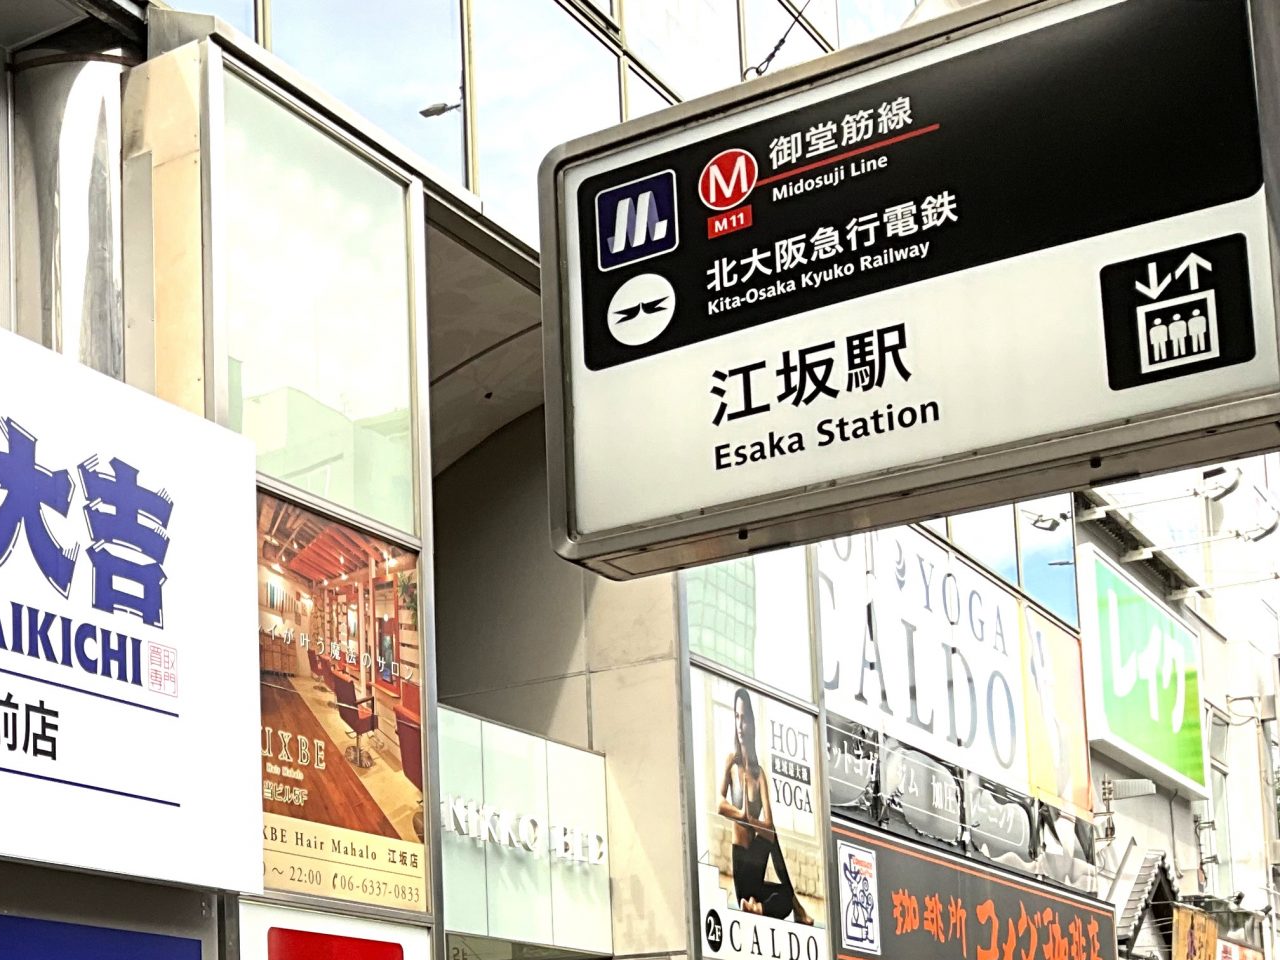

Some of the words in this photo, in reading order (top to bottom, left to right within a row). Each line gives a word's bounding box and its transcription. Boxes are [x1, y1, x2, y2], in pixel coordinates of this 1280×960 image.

[769, 96, 913, 170] 御堂筋線
[772, 166, 845, 202] Midosuji
[851, 155, 888, 178] Line
[706, 190, 959, 292] 北大阪急行電鉄
[714, 213, 745, 233] M11
[708, 279, 796, 315] Kita-Osaka
[801, 262, 855, 288] Kyuko
[860, 241, 930, 272] Railway
[710, 322, 912, 427] 江坂駅
[715, 431, 806, 470] Esaka
[817, 400, 940, 447] Station
[916, 553, 1008, 657] YOGA
[770, 720, 808, 762] HOT
[263, 780, 308, 806] 当ビル5F
[772, 778, 813, 813] YOGA
[295, 832, 325, 851] Hair
[331, 839, 377, 860] Mahalo
[387, 849, 419, 869] 江坂店
[289, 866, 322, 885] 22:00
[340, 875, 420, 903] 06-6337-0833
[707, 917, 722, 942] 2F
